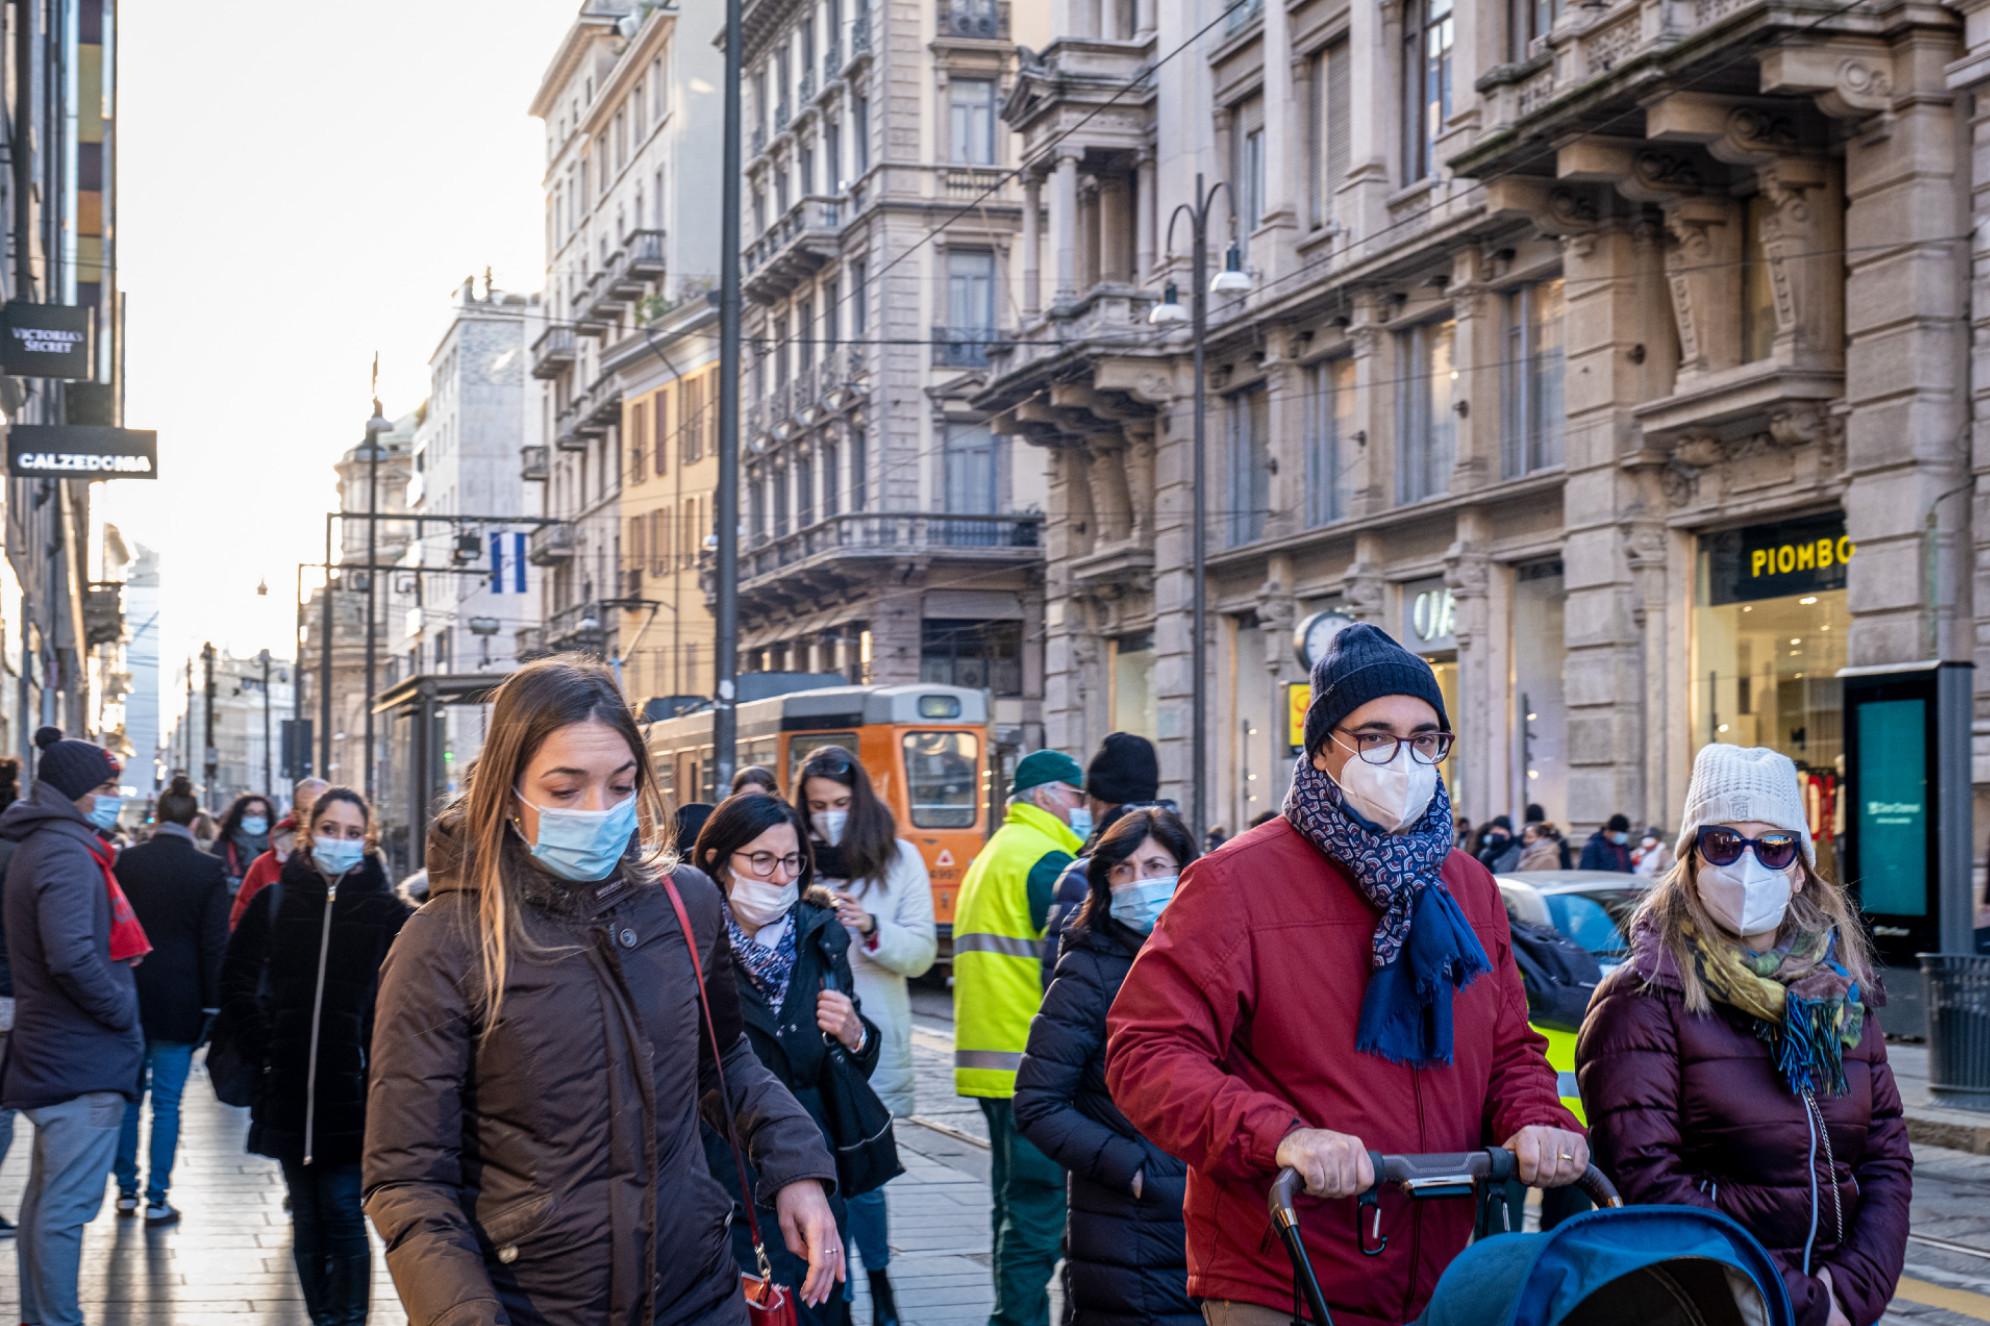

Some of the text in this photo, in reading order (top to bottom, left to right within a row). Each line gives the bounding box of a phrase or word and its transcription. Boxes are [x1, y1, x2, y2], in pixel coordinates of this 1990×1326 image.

[24, 341, 72, 353] SECRET
[18, 453, 151, 472] CALZEDONIA
[1751, 534, 1856, 578] PIOMBO
